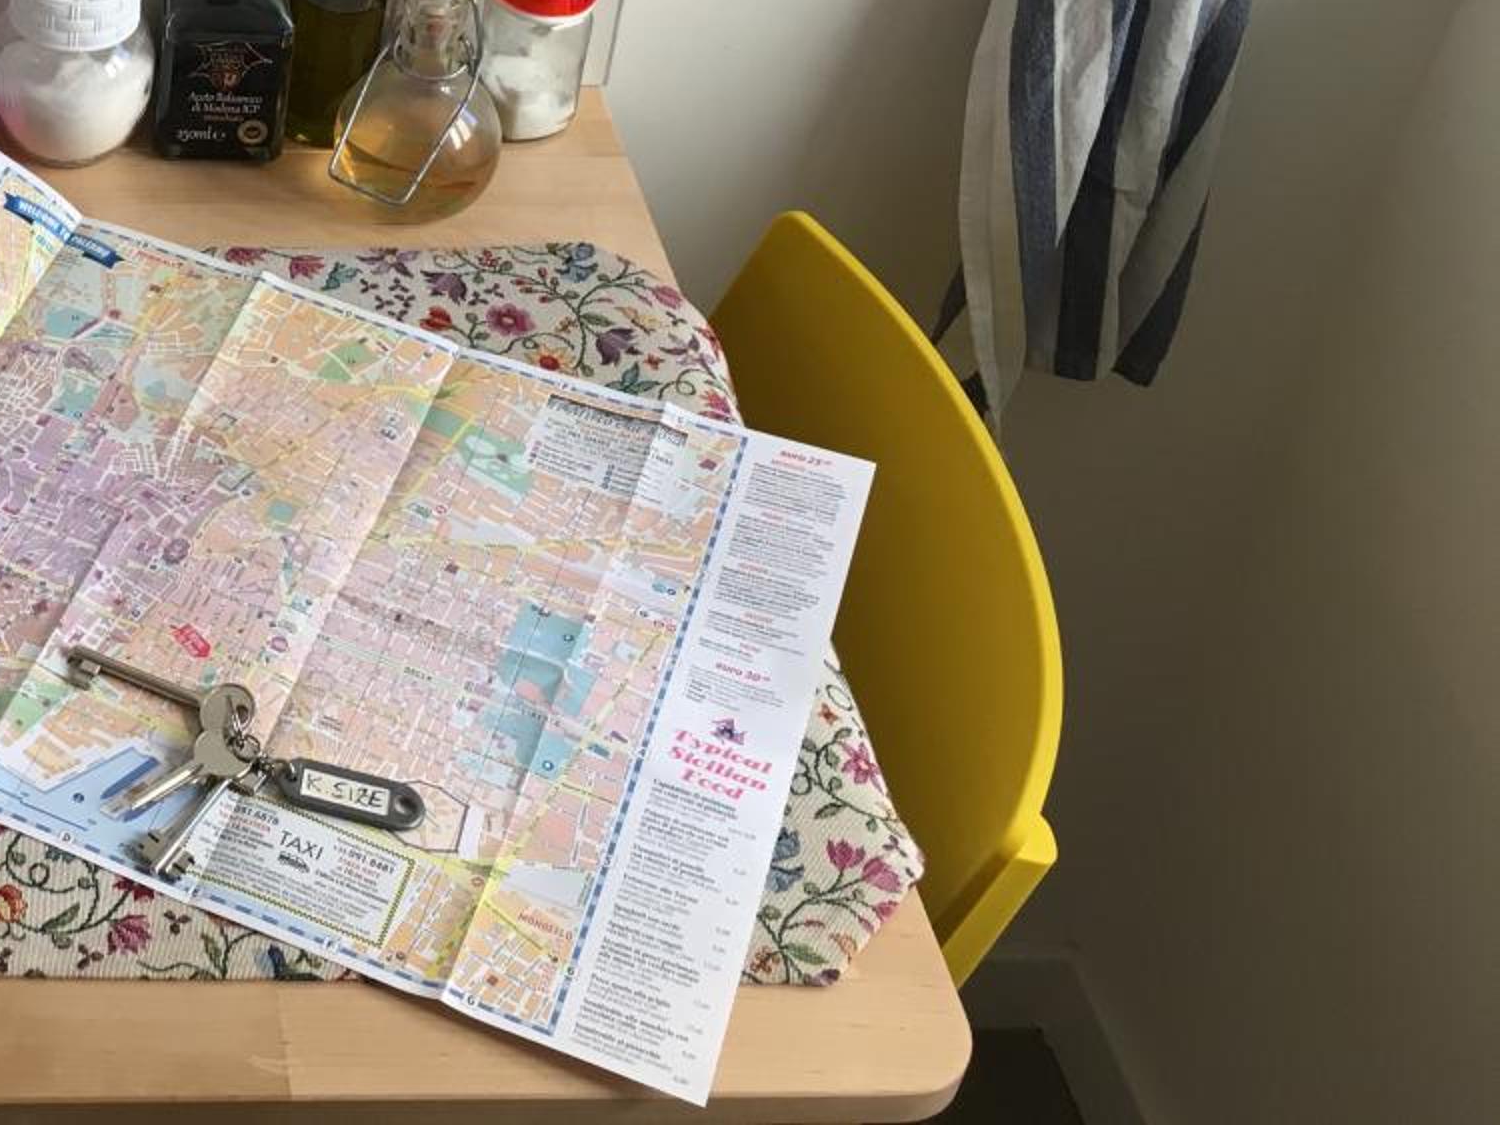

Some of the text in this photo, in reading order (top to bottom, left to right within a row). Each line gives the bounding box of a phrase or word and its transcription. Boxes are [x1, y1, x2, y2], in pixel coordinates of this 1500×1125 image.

[669, 746, 768, 792] Sicilian
[673, 729, 773, 774] Typical
[680, 768, 745, 801] Food
[279, 830, 325, 862] TAXI
